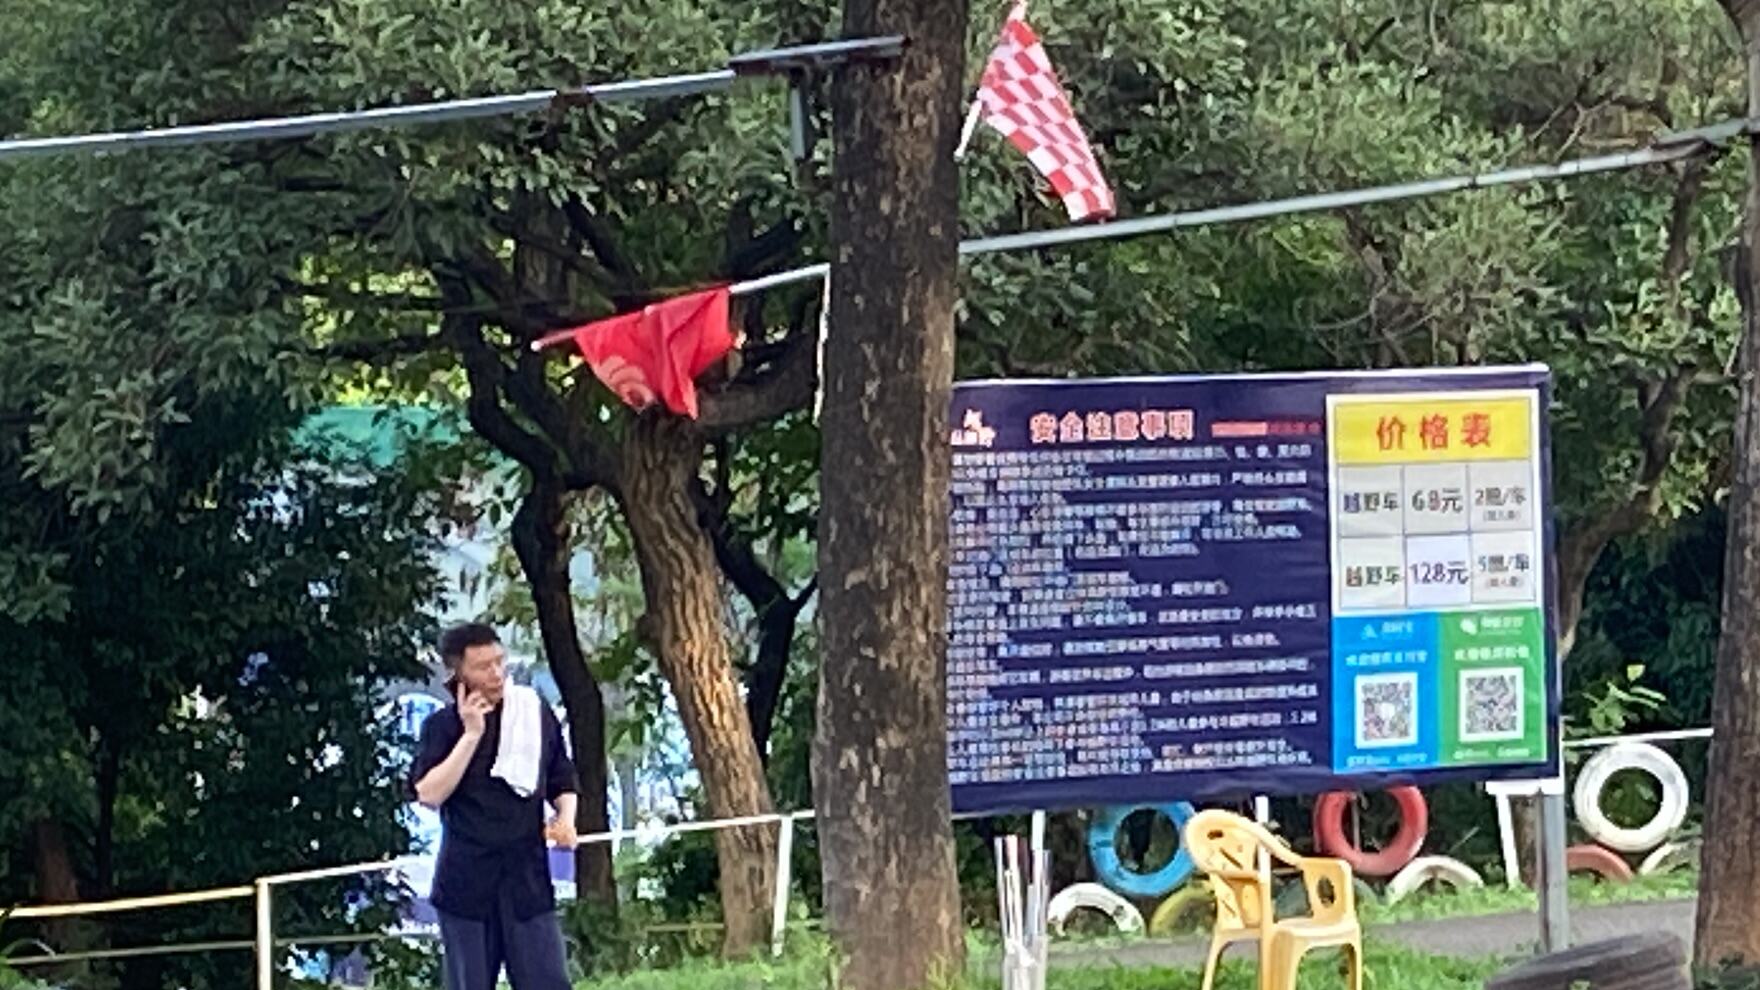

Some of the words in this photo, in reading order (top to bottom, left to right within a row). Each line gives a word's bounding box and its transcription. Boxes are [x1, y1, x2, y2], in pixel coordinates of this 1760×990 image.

[1376, 412, 1491, 451] 价格表
[1343, 491, 1399, 514] 越野车
[1411, 487, 1463, 514] 68元
[1345, 565, 1401, 588] 越野车
[1409, 560, 1469, 585] 128元
